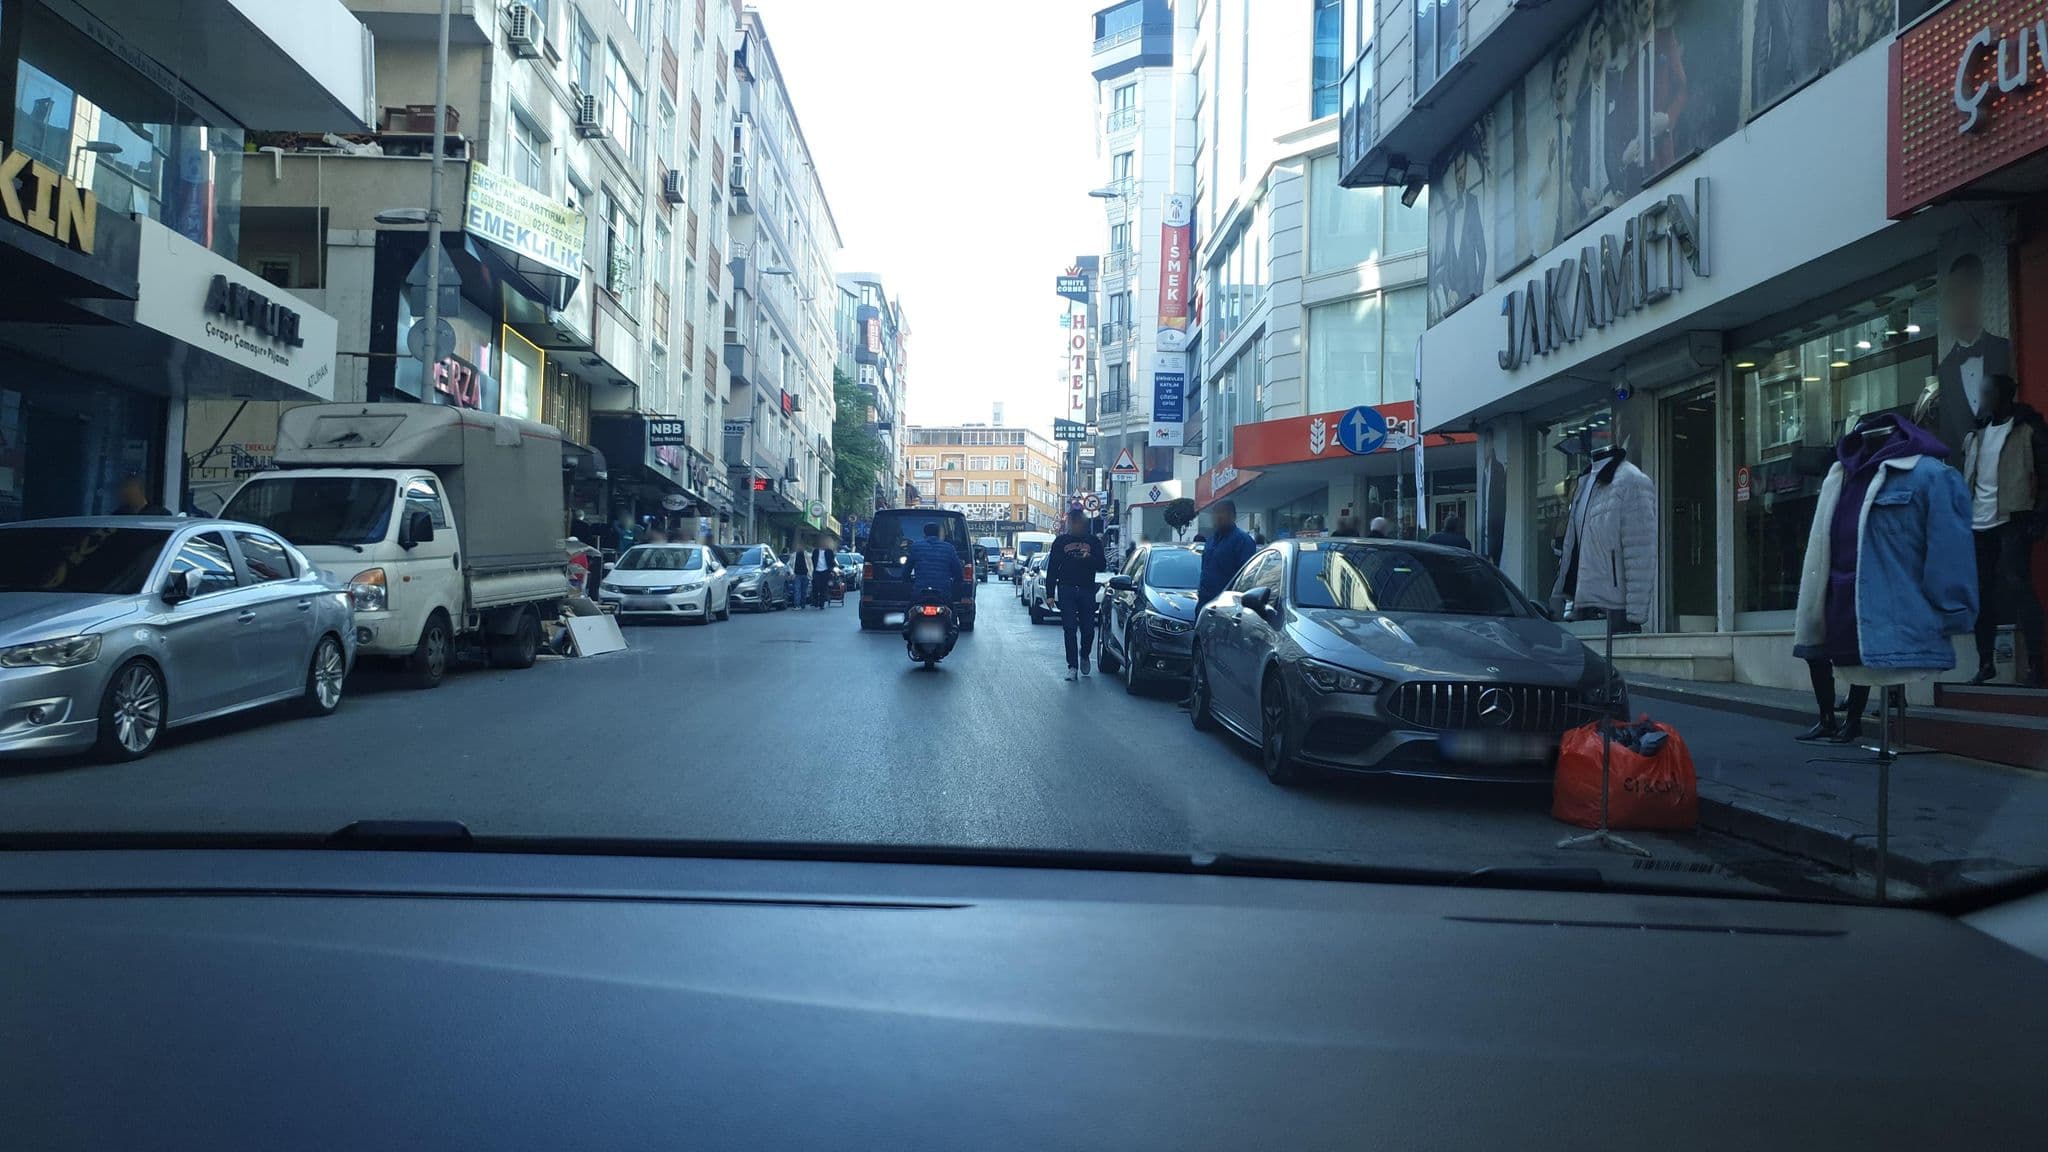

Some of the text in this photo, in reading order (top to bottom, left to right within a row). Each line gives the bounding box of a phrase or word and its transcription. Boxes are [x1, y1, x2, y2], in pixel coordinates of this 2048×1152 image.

[468, 206, 581, 272] EMEKLİLİK
[1167, 230, 1182, 301] İSMEK
[1498, 177, 1710, 370] JAKAMEN
[1072, 314, 1086, 410] HOTEL
[652, 423, 683, 434] NBB
